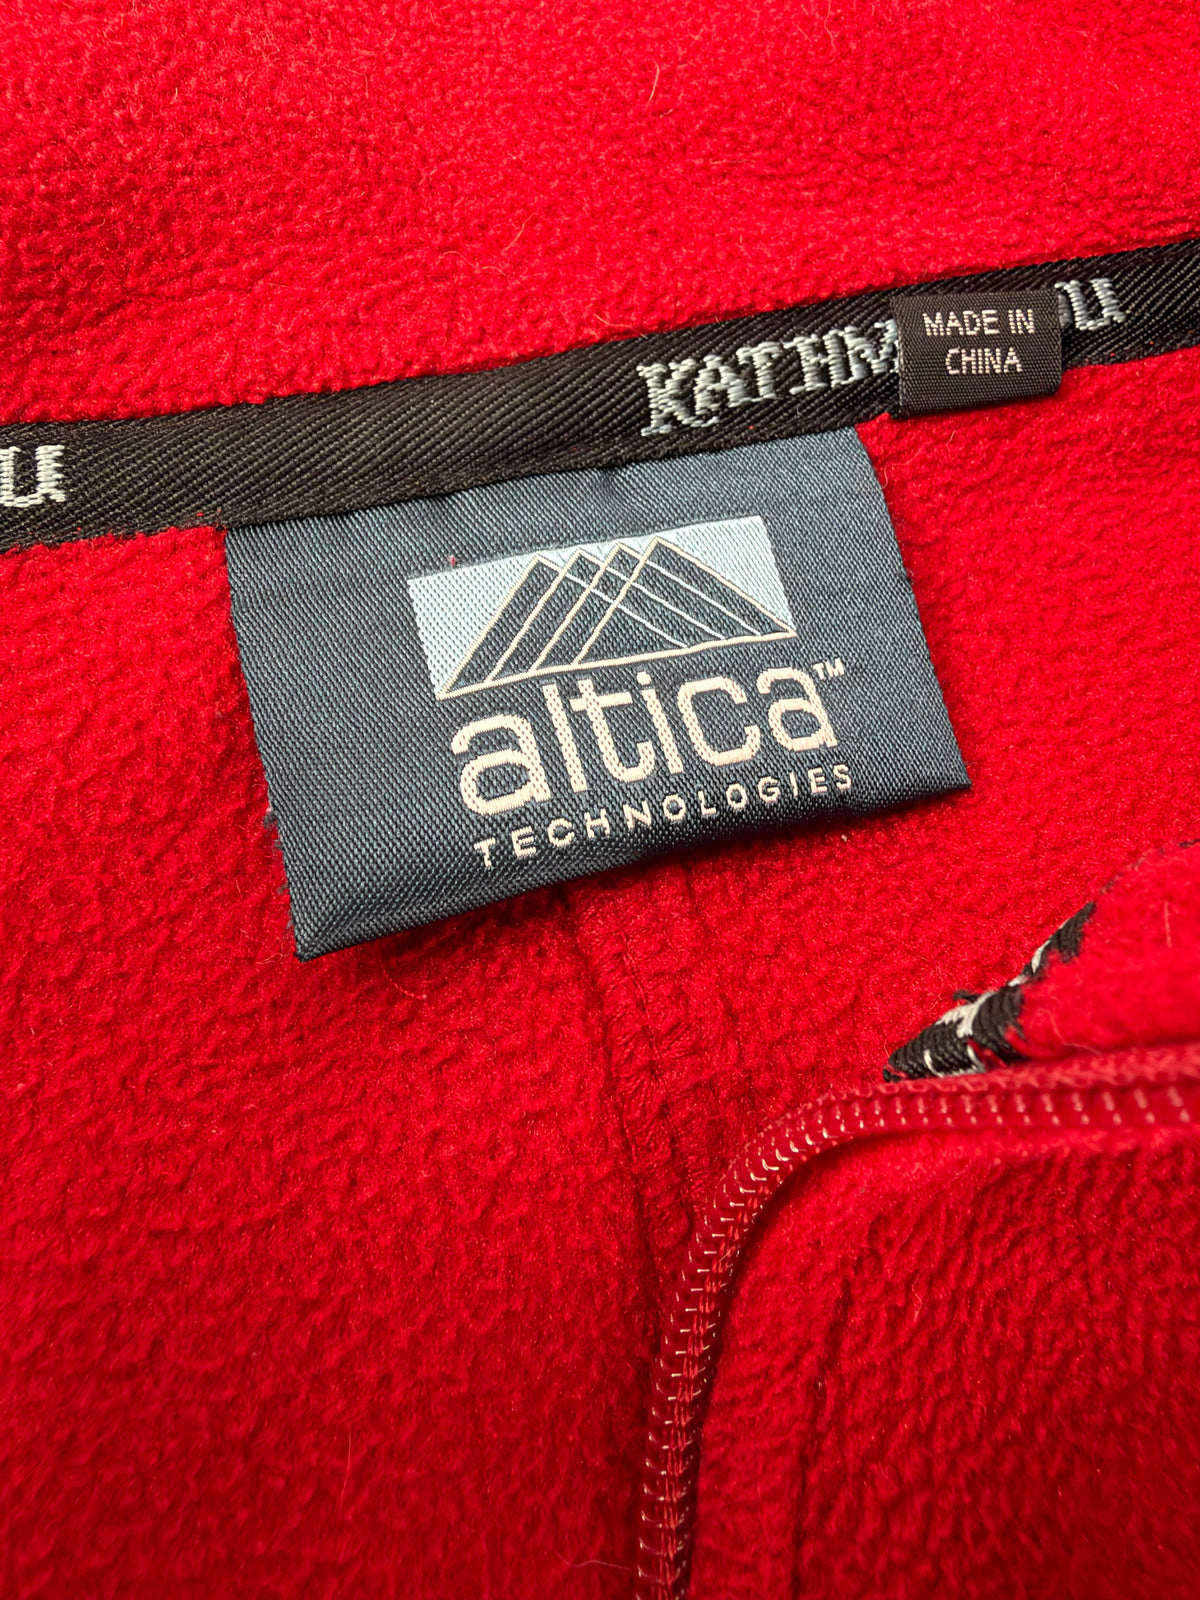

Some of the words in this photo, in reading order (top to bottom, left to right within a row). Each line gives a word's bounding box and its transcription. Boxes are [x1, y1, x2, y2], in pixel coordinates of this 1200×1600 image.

[923, 309, 1000, 337] MADE
[1008, 308, 1035, 335] IN
[945, 347, 1023, 375] CHINA
[451, 667, 838, 816] altica
[473, 764, 853, 867] TECHNOLOGIES
